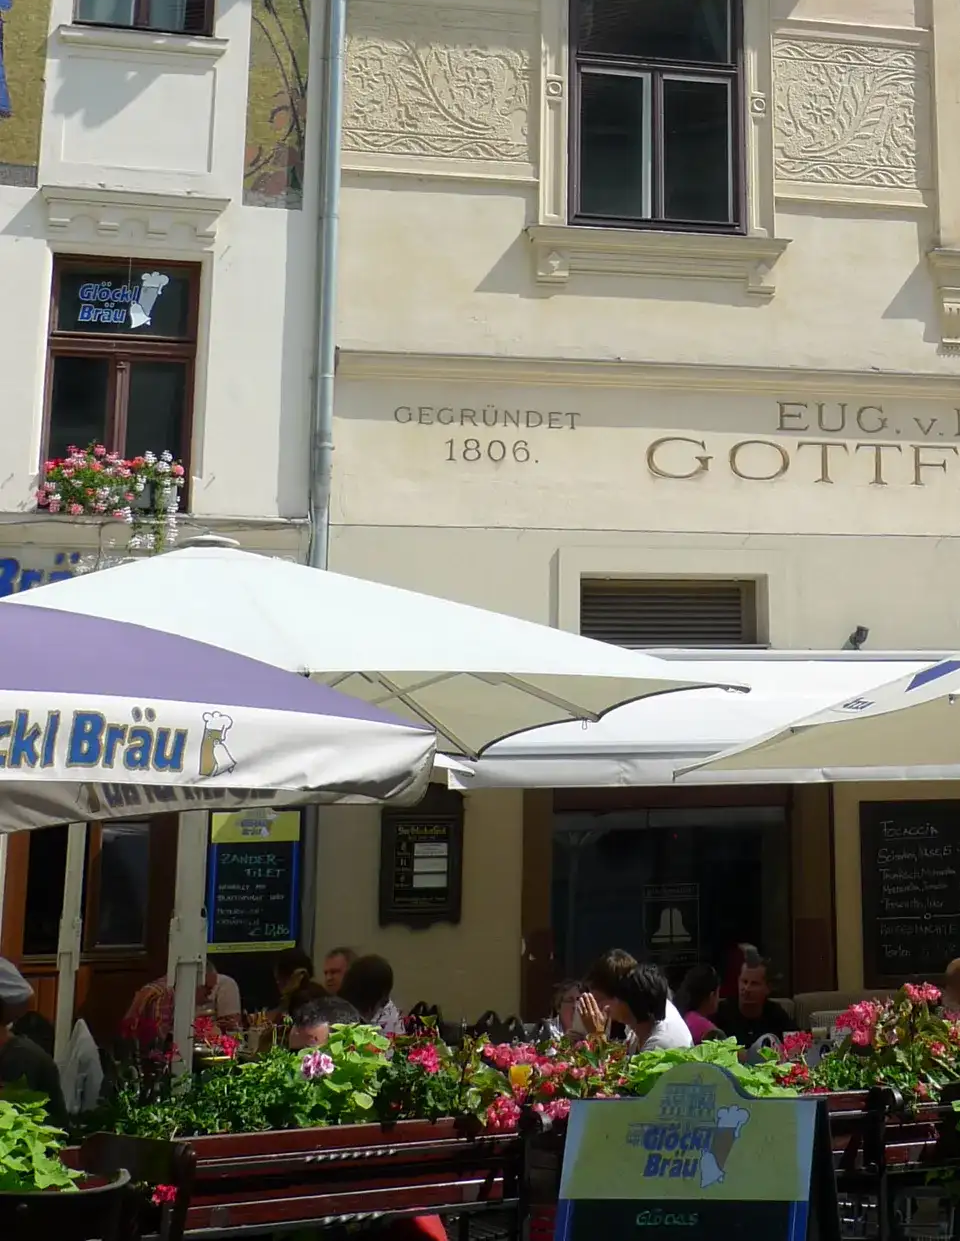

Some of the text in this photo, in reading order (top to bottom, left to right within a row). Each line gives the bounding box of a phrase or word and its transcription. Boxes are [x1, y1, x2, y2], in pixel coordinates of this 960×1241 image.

[79, 281, 140, 305] Glöckl
[77, 302, 127, 324] Bräu
[393, 404, 582, 431] GEGRÜNDET
[776, 400, 902, 435] EUG.
[444, 437, 540, 464] 1806.
[65, 706, 188, 772] Bräu
[643, 1122, 712, 1152] Glöckl
[642, 1150, 699, 1179] Bräu
